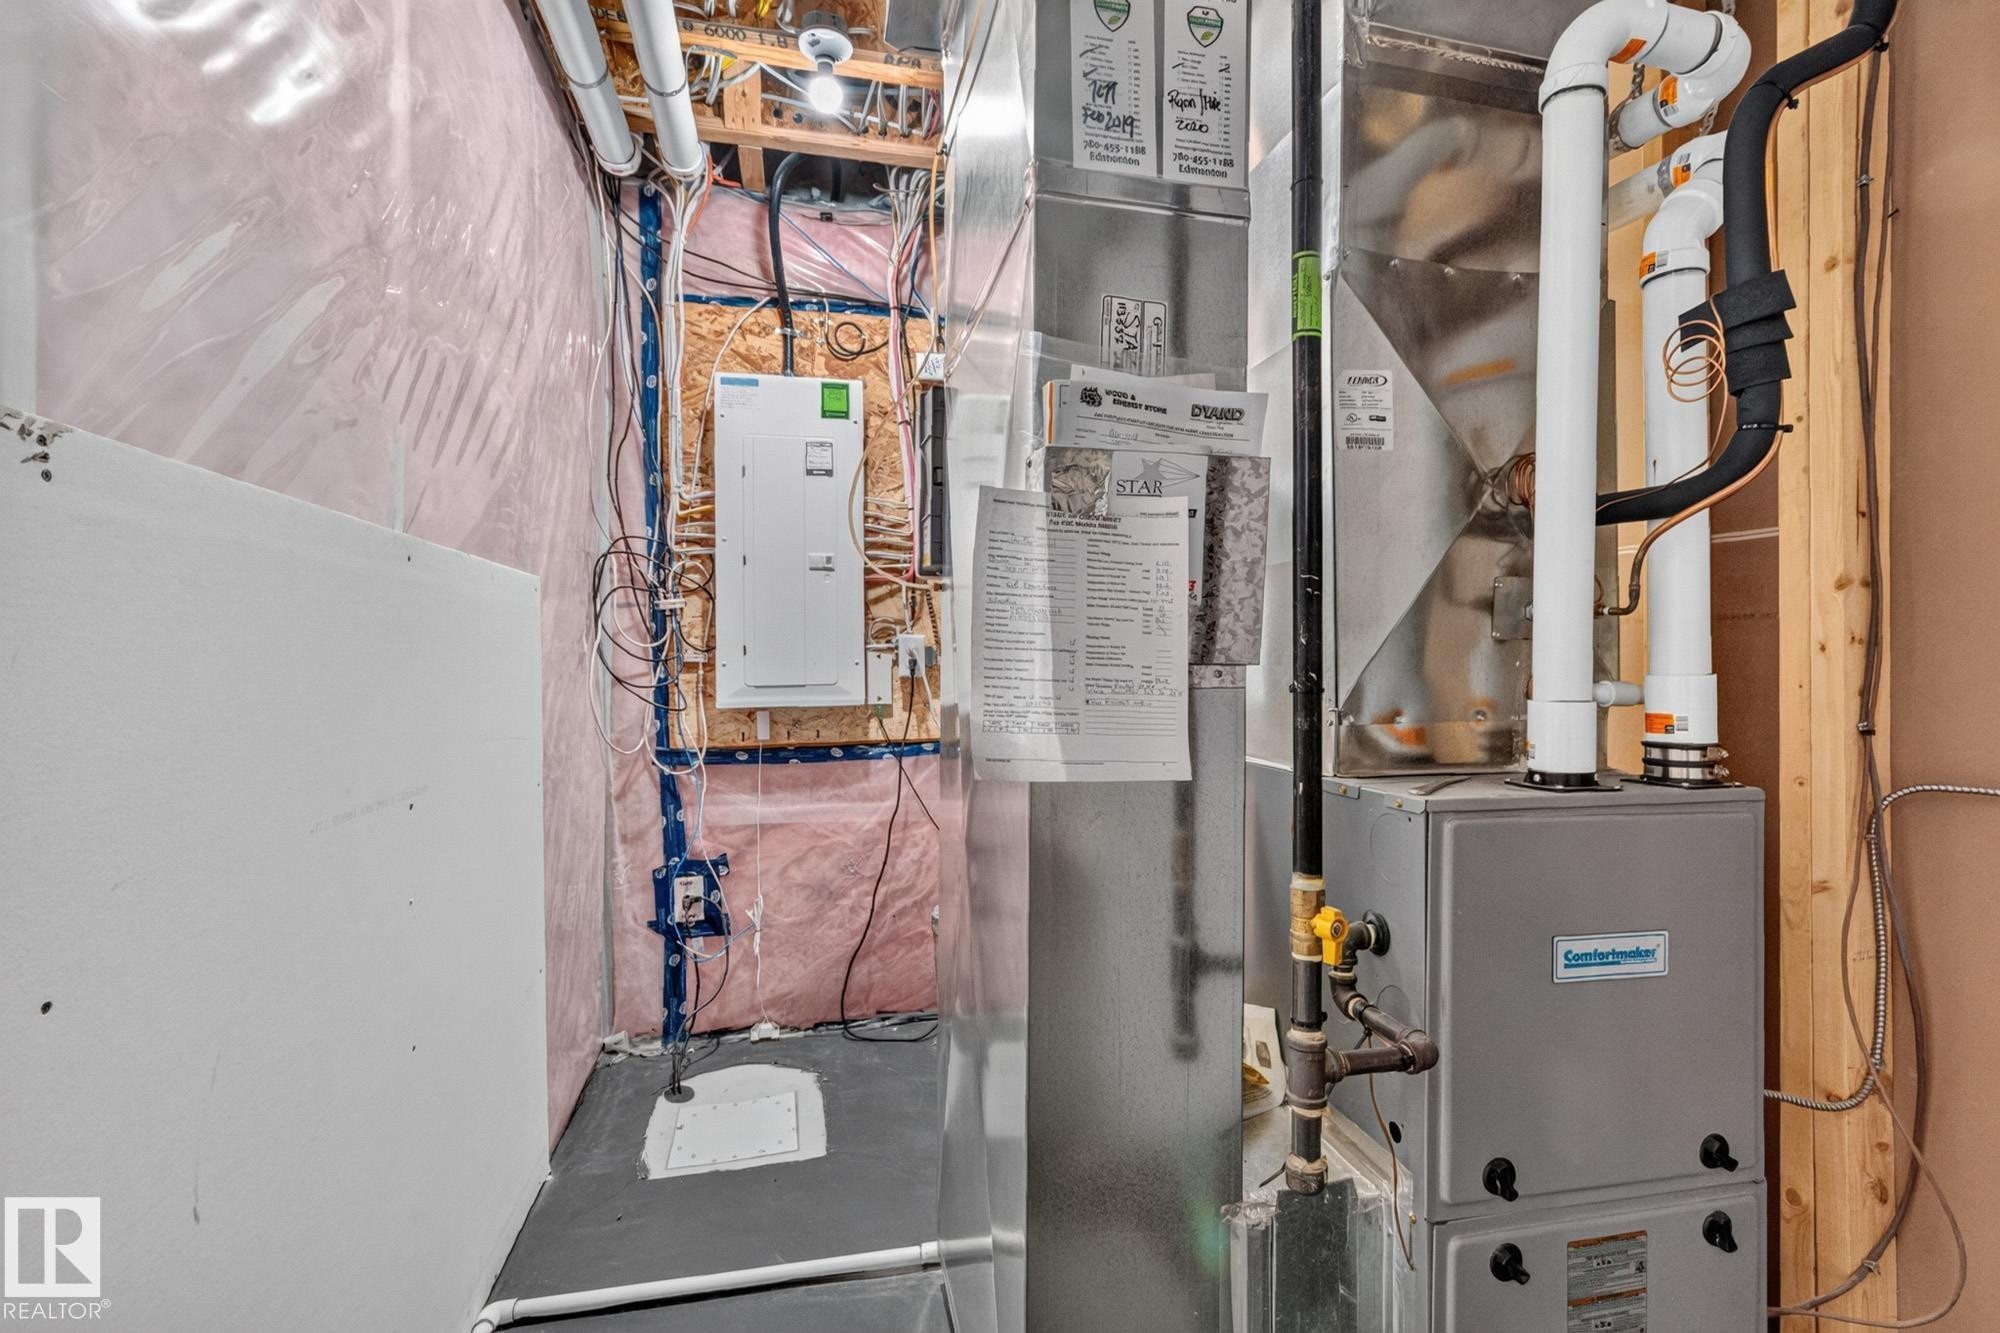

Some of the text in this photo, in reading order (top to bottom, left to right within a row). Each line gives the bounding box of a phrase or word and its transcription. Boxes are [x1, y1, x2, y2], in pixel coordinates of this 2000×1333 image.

[1104, 111, 1134, 138] 2019
[1179, 164, 1227, 178] Edmonton
[1116, 479, 1163, 494] STAR
[1563, 945, 1657, 963] Comfortmaker
